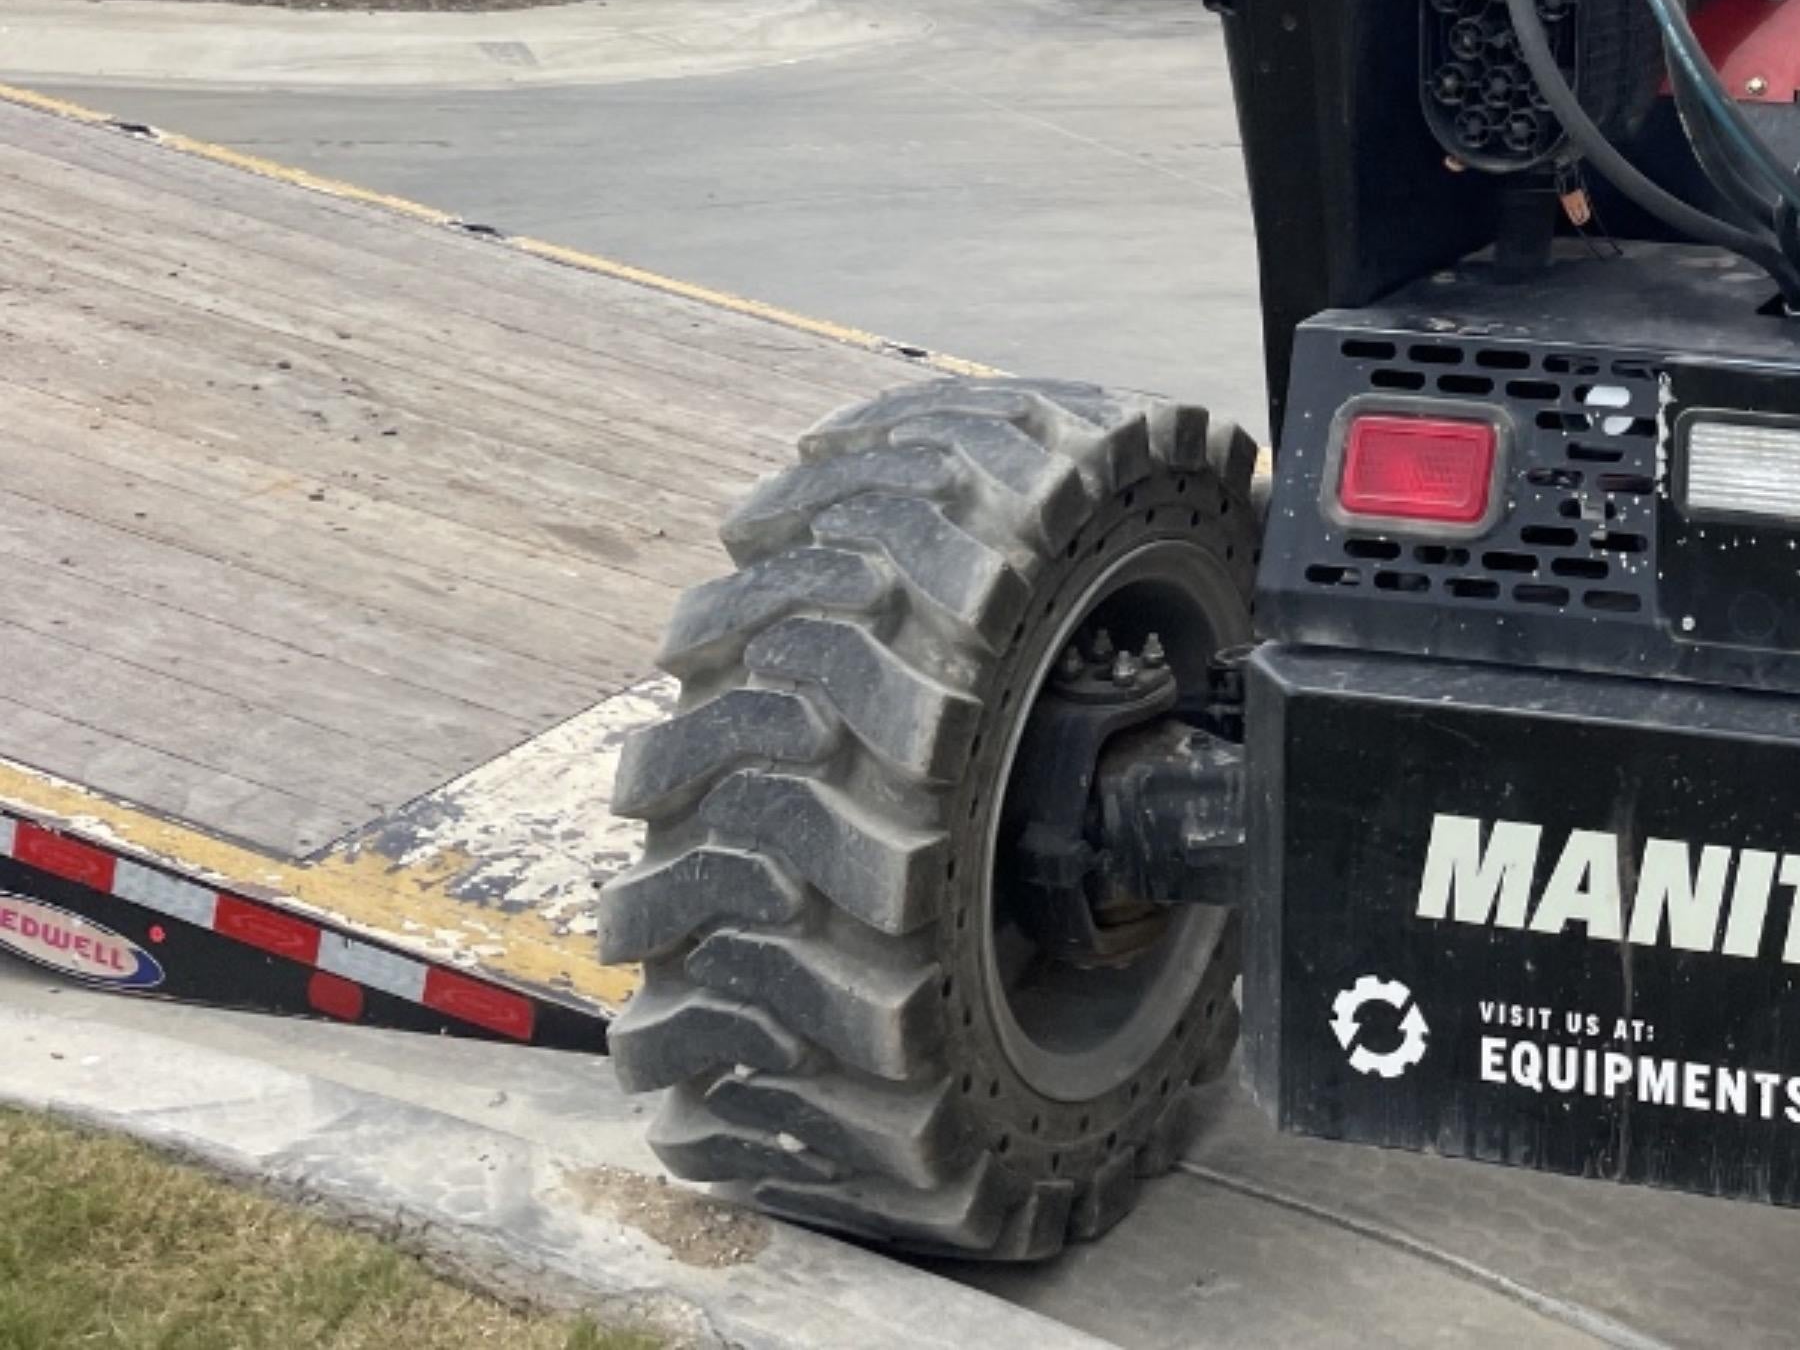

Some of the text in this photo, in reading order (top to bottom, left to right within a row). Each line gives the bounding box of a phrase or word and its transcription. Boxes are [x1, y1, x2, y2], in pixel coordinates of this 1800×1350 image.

[1479, 1001, 1655, 1043] VISIT US AT:
